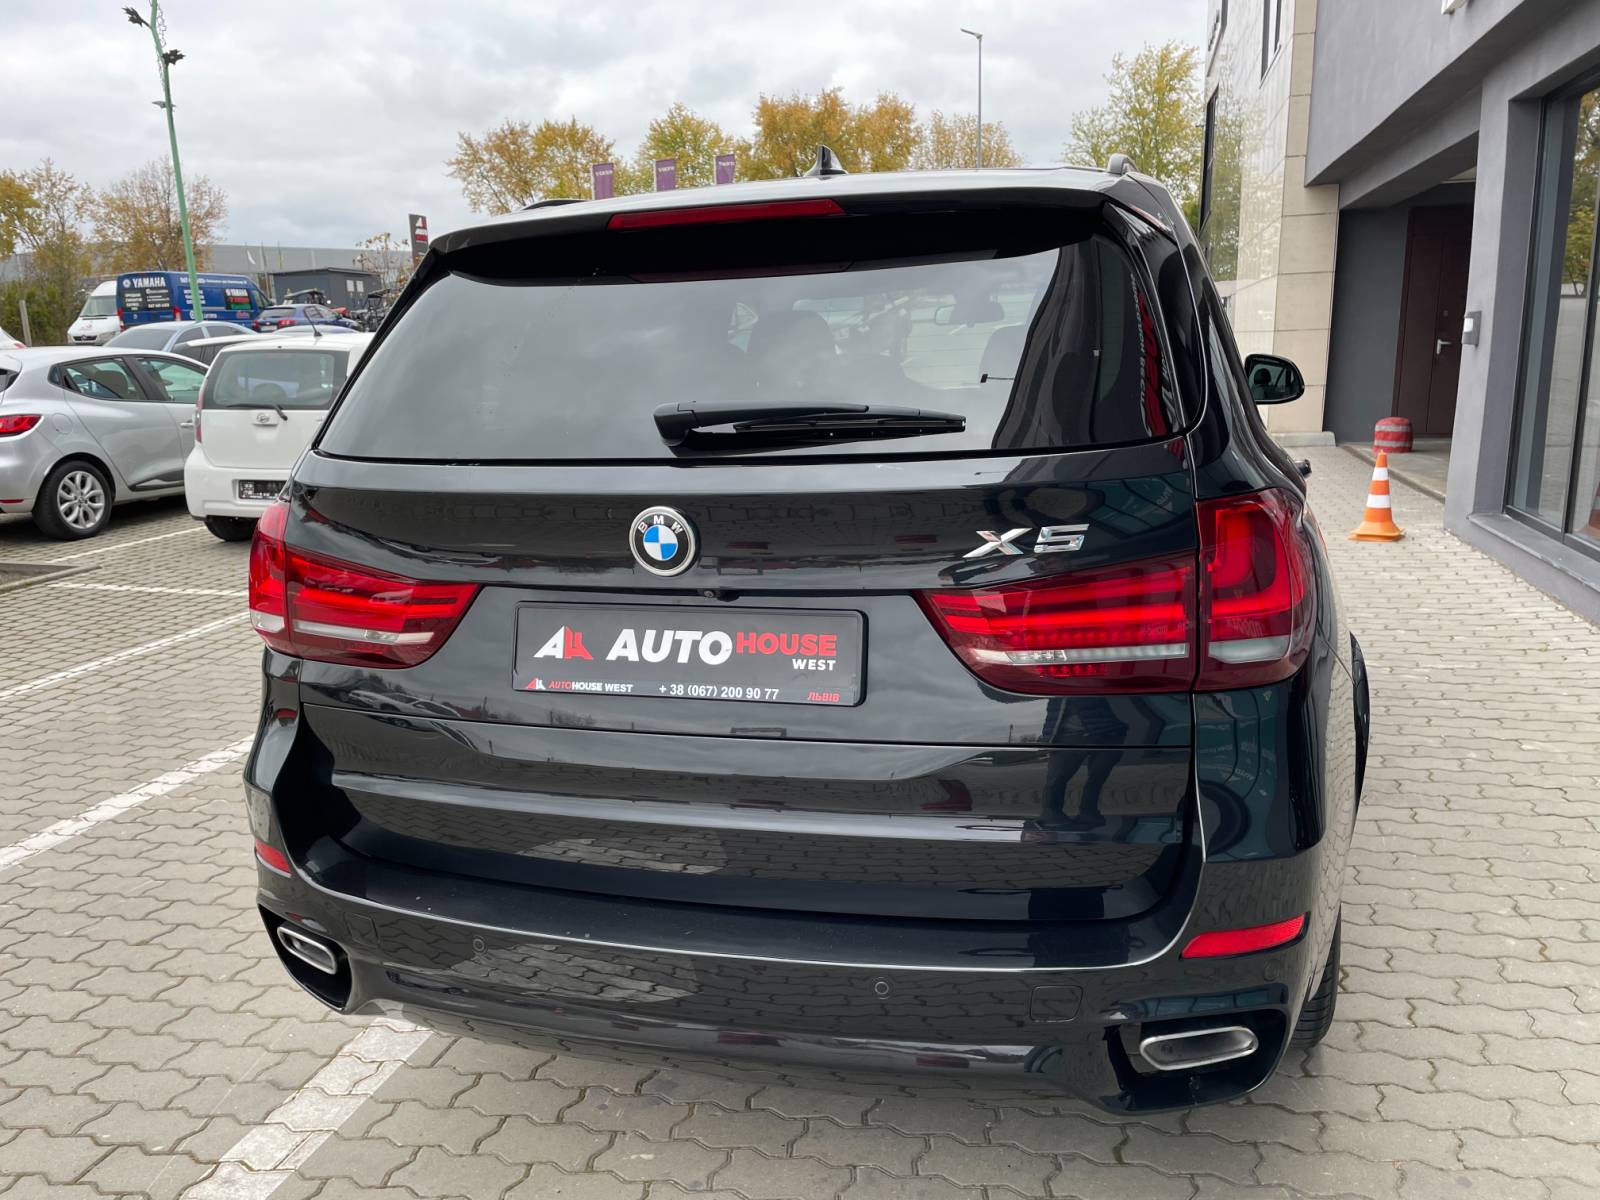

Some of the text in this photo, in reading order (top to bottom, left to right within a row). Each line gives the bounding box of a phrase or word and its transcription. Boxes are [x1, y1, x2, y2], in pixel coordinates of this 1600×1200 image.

[132, 277, 166, 288] YAMAHA
[637, 514, 684, 535] BMW
[961, 523, 1090, 558] X5
[792, 658, 837, 671] WEST
[604, 683, 634, 693] WEST
[670, 684, 684, 696] 38
[687, 685, 718, 698] (067)
[721, 686, 743, 699] 200
[746, 688, 761, 700] 90
[764, 688, 780, 700] 77
